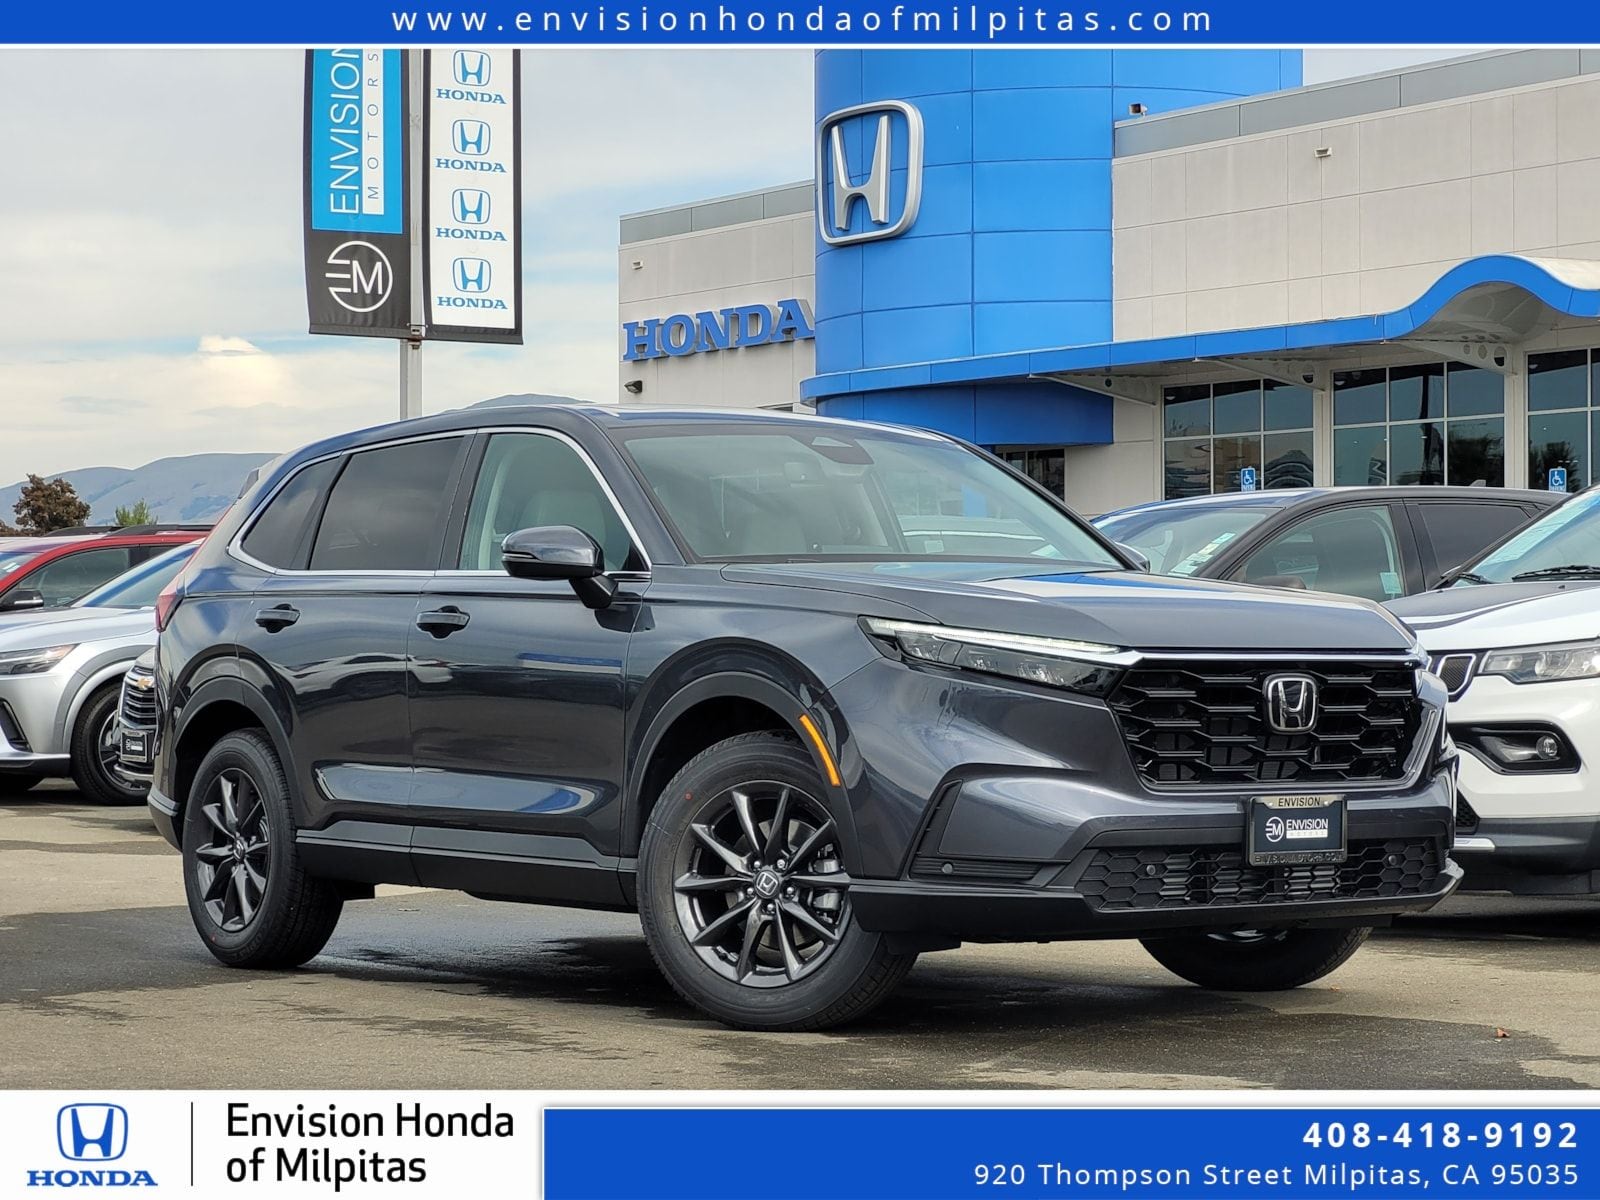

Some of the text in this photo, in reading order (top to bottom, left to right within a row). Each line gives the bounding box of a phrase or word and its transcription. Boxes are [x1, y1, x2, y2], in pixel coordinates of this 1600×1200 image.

[436, 88, 506, 105] HONDA
[367, 53, 379, 200] MOTORS
[436, 158, 506, 173] HONDA
[436, 227, 506, 242] HONDA
[437, 296, 507, 310] HONDA
[622, 298, 815, 361] HONDA
[1278, 796, 1321, 808] ENVISION
[1286, 818, 1329, 830] ENVISION
